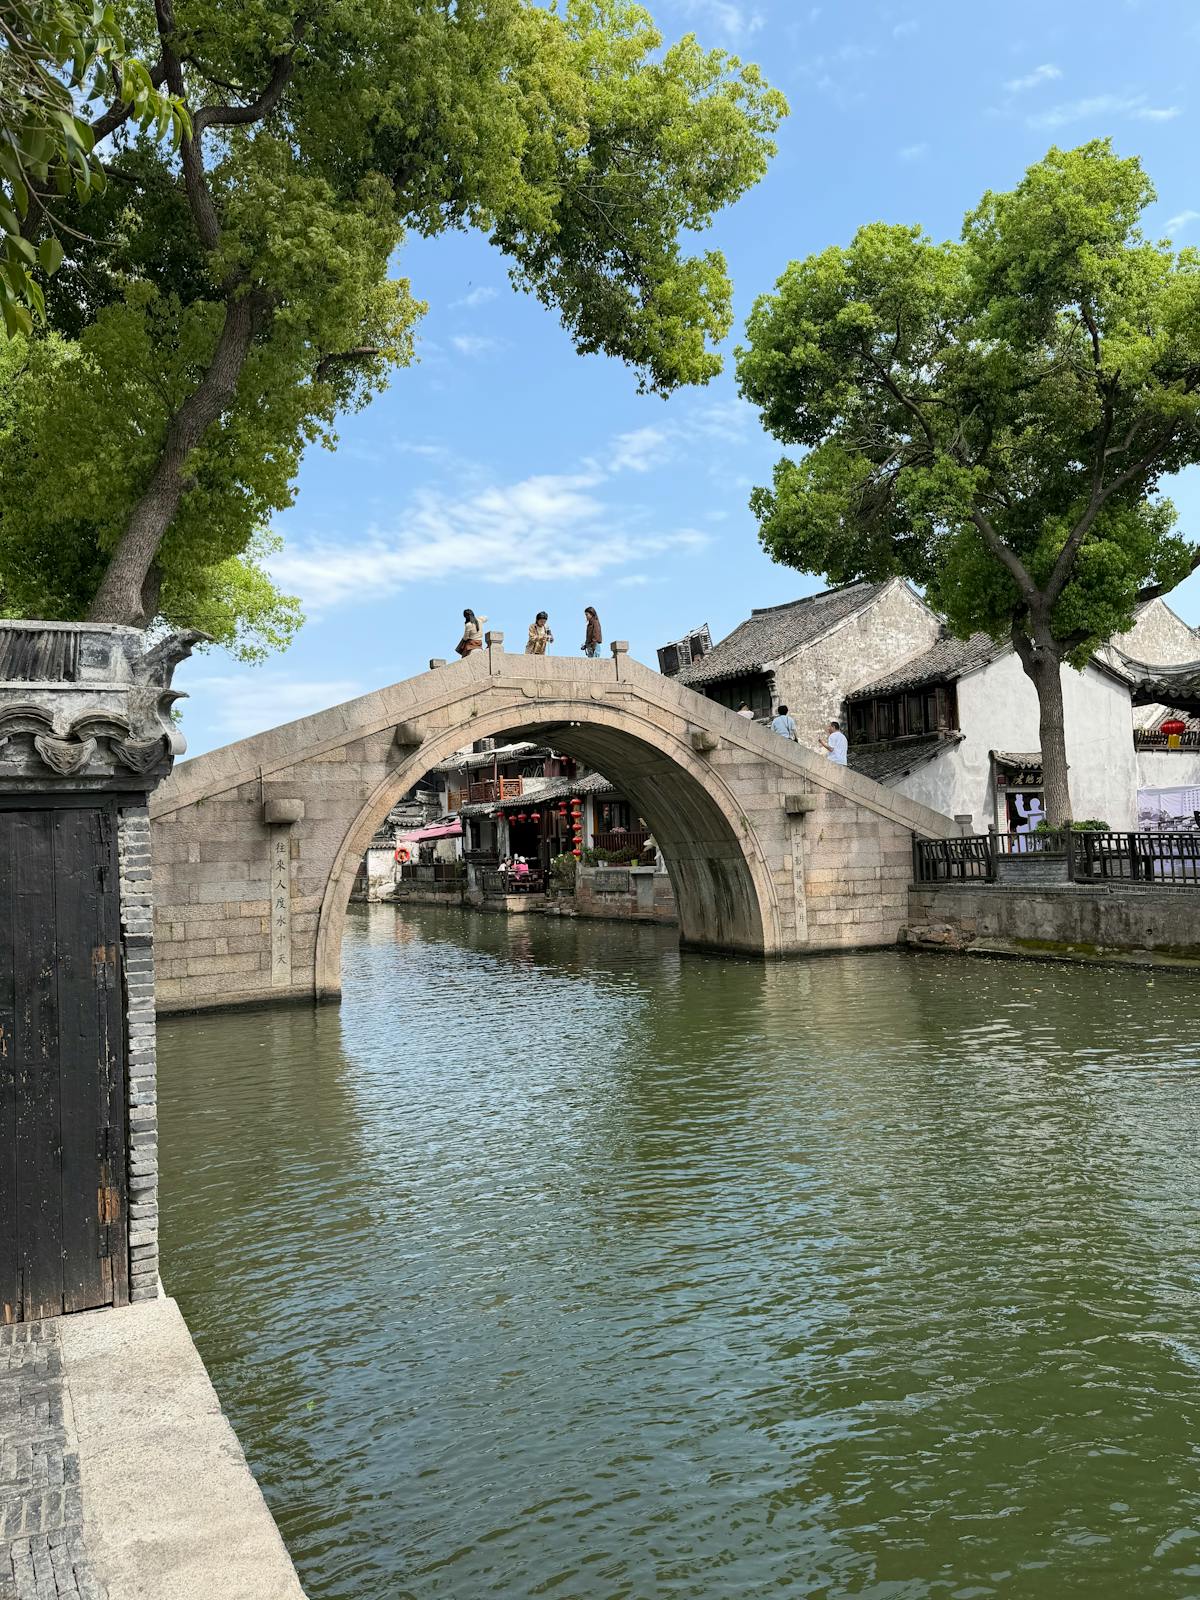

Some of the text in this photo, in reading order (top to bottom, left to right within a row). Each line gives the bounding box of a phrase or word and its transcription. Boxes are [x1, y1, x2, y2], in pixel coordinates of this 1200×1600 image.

[275, 841, 287, 965] 往來人度水中天
